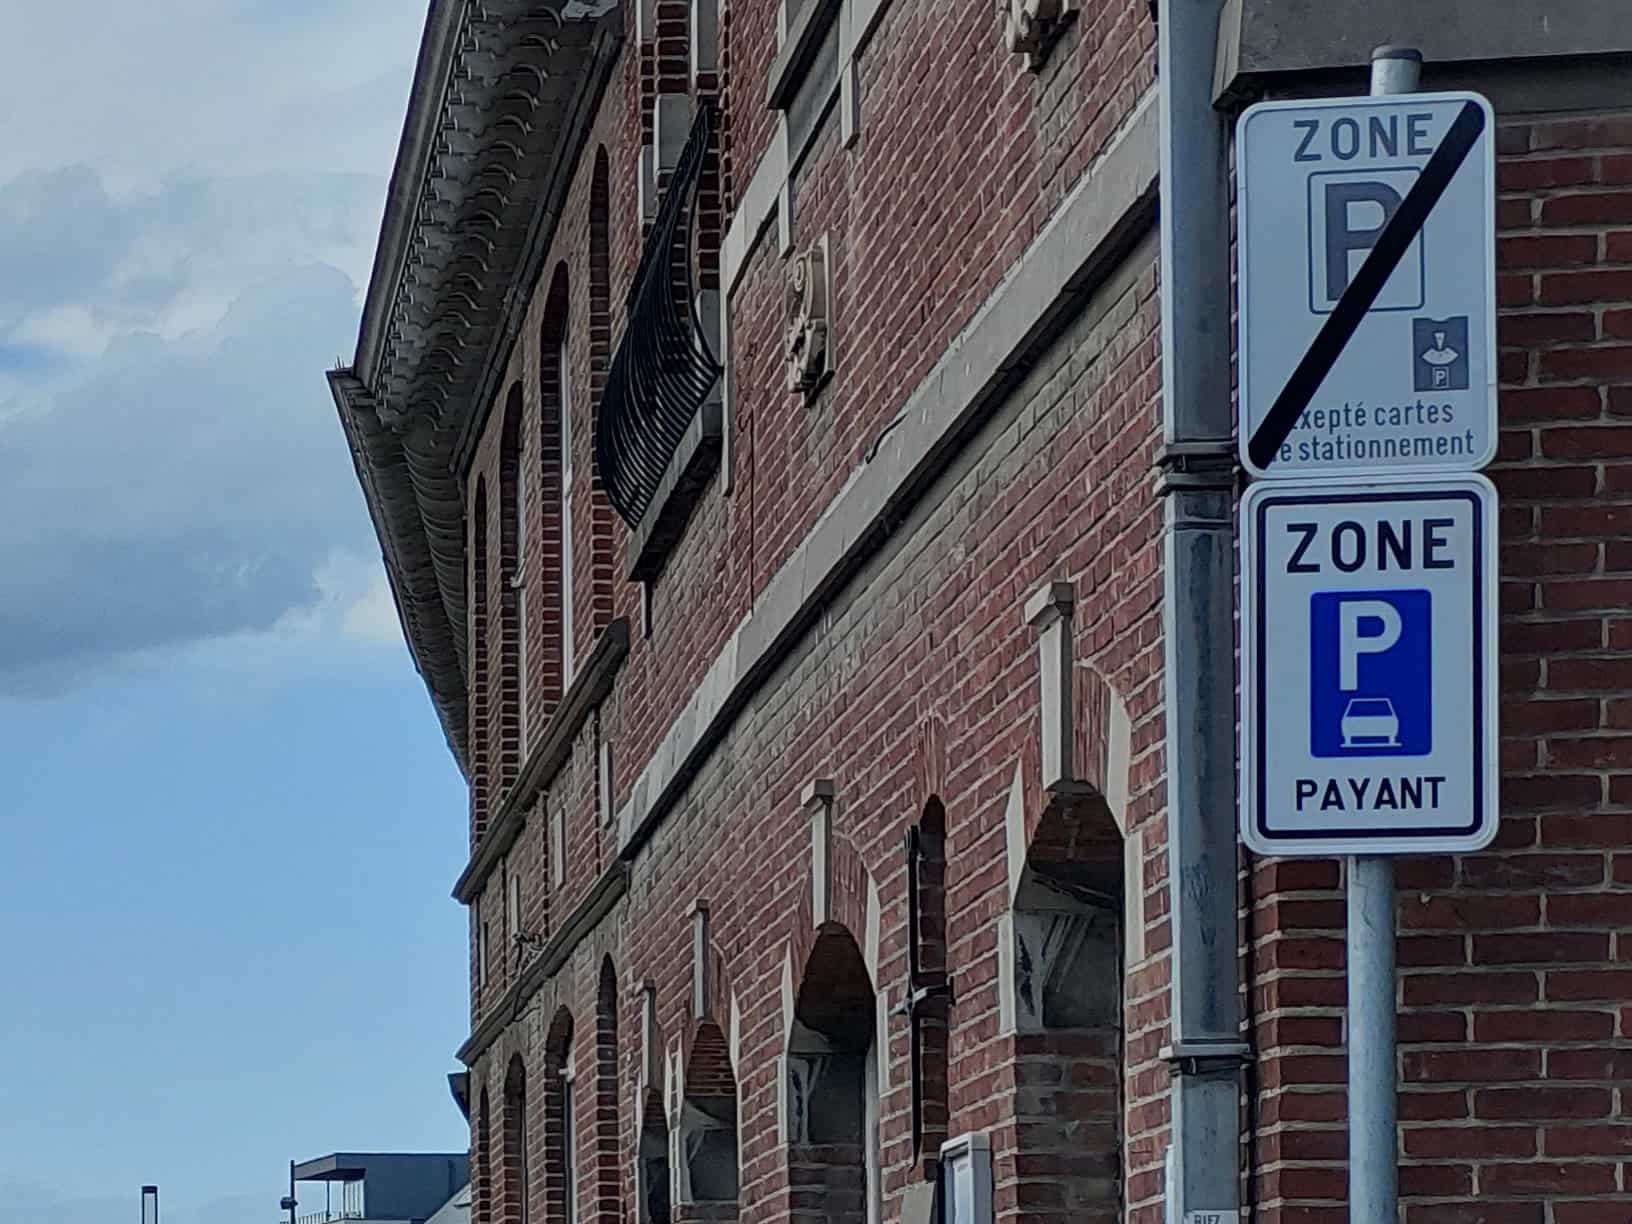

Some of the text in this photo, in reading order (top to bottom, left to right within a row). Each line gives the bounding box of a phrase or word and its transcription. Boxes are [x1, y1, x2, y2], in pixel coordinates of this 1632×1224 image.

[1293, 113, 1434, 162] ZONE
[1290, 400, 1454, 434] xepté cartes
[1299, 429, 1475, 462] stationnement
[1286, 518, 1455, 573] ZONE
[1339, 600, 1403, 691] P
[1296, 776, 1446, 811] PAYANT
